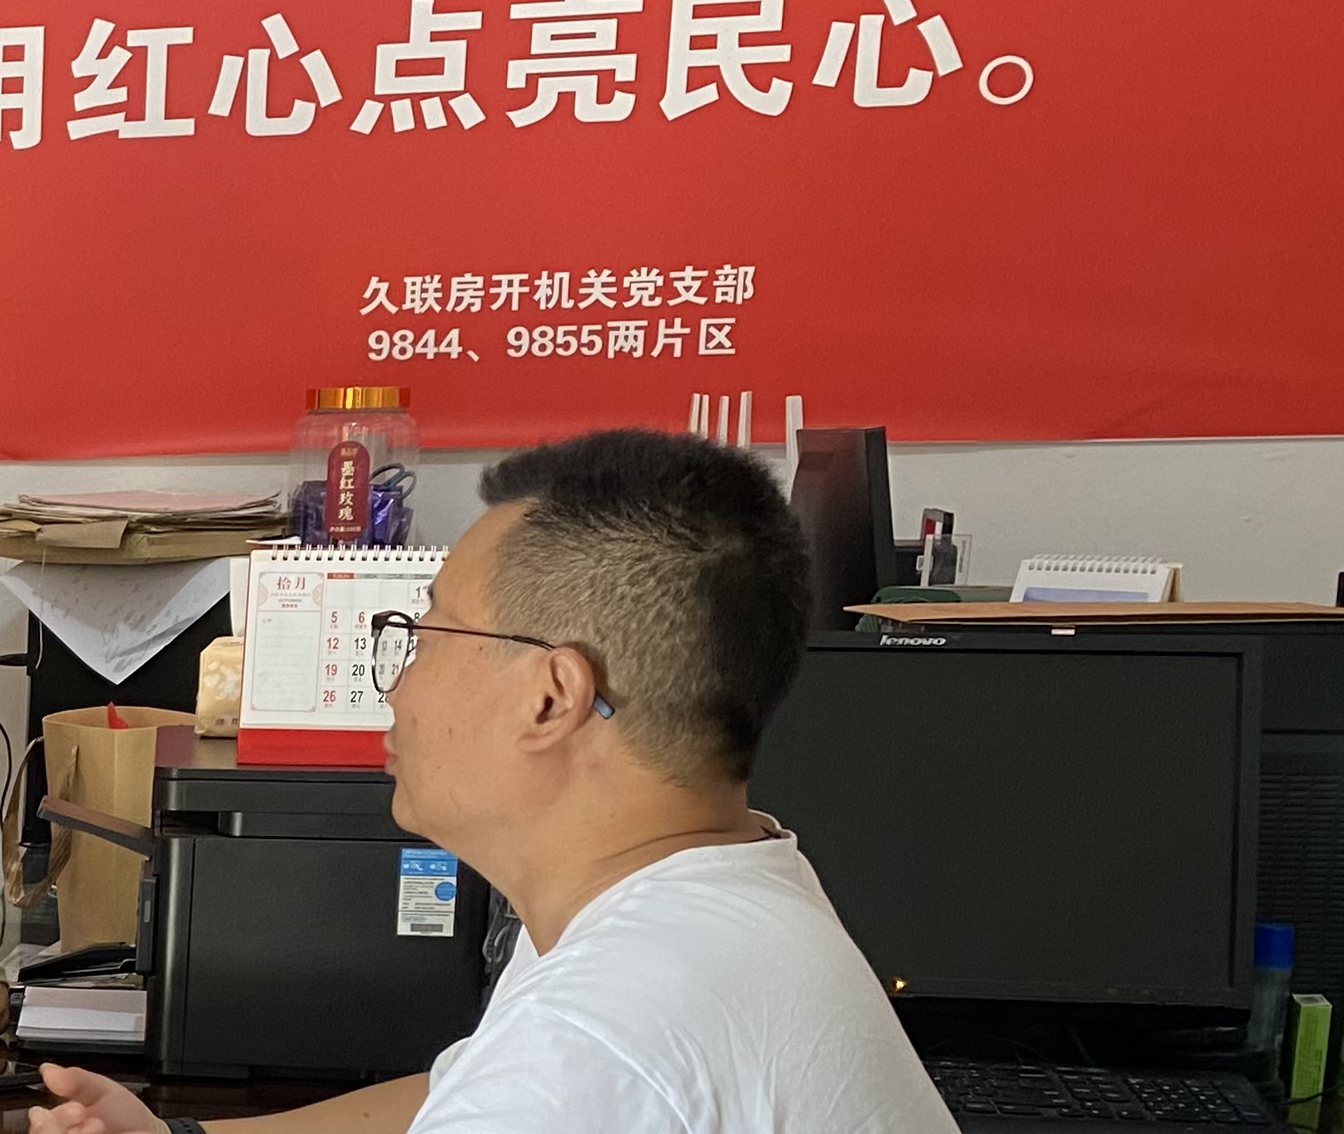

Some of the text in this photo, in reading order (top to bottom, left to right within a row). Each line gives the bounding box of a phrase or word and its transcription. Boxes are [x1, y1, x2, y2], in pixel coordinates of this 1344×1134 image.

[359, 264, 756, 316] 久联房开机关党支部
[367, 317, 736, 363] 9844、9855两片区
[338, 460, 355, 521] 墨红玫瑰
[277, 576, 306, 590] 拾月
[331, 611, 338, 623] 5
[358, 611, 365, 623] 6
[326, 637, 339, 650] 12
[354, 637, 367, 650] 13
[879, 634, 947, 647] lenovo
[325, 664, 338, 676] 19
[352, 664, 365, 676] 20
[323, 690, 336, 703] 26
[350, 690, 363, 703] 27
